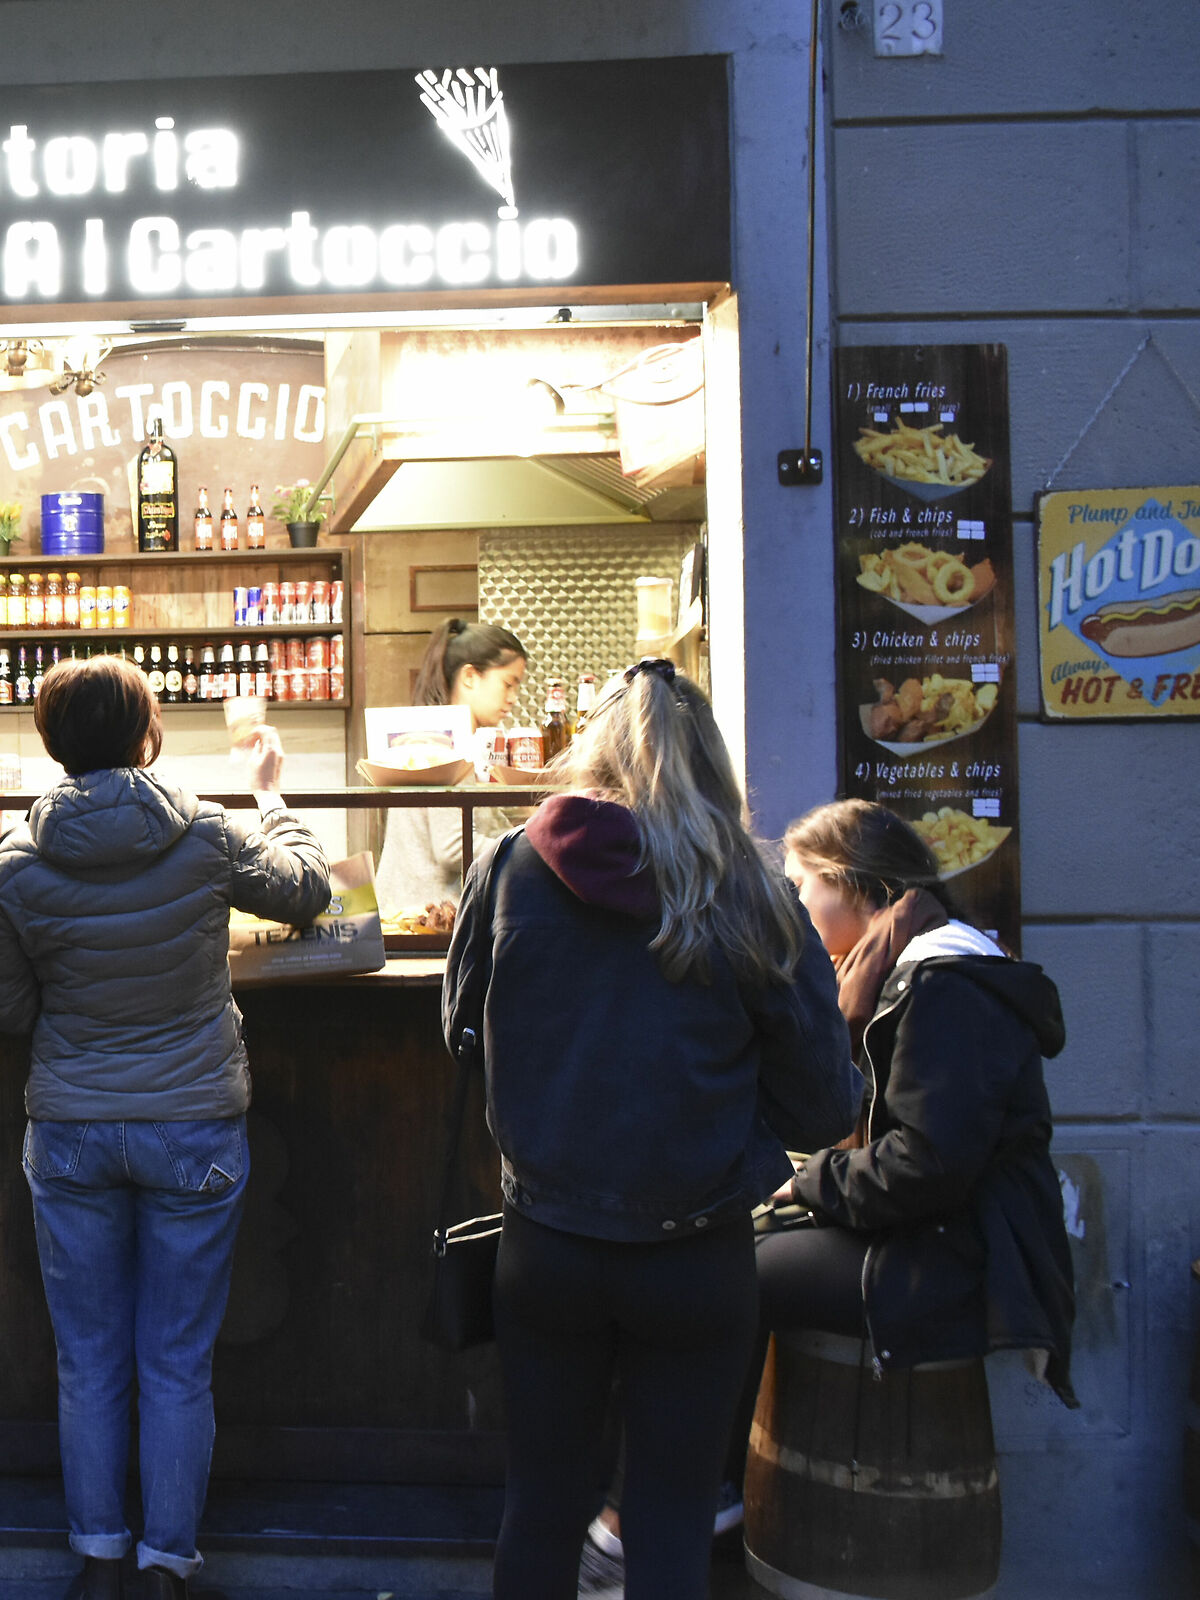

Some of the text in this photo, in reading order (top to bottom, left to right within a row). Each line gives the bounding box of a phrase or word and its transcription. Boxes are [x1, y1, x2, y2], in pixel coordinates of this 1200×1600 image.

[880, 1, 938, 41] 23
[128, 205, 579, 296] Cartoccio
[866, 382, 910, 399] French
[914, 380, 947, 398] fries
[869, 507, 897, 523] Fish
[902, 507, 912, 523] &
[917, 506, 953, 527] chips
[1067, 503, 1129, 525] Plump
[1134, 500, 1173, 520] and
[1048, 528, 1200, 633] Hot Do
[852, 629, 981, 651] 3) Chicken & chips
[1051, 660, 1110, 685] Always
[1060, 674, 1122, 705] HOT
[1126, 677, 1144, 699] &
[855, 760, 1001, 785] 4) Vegetables & chips
